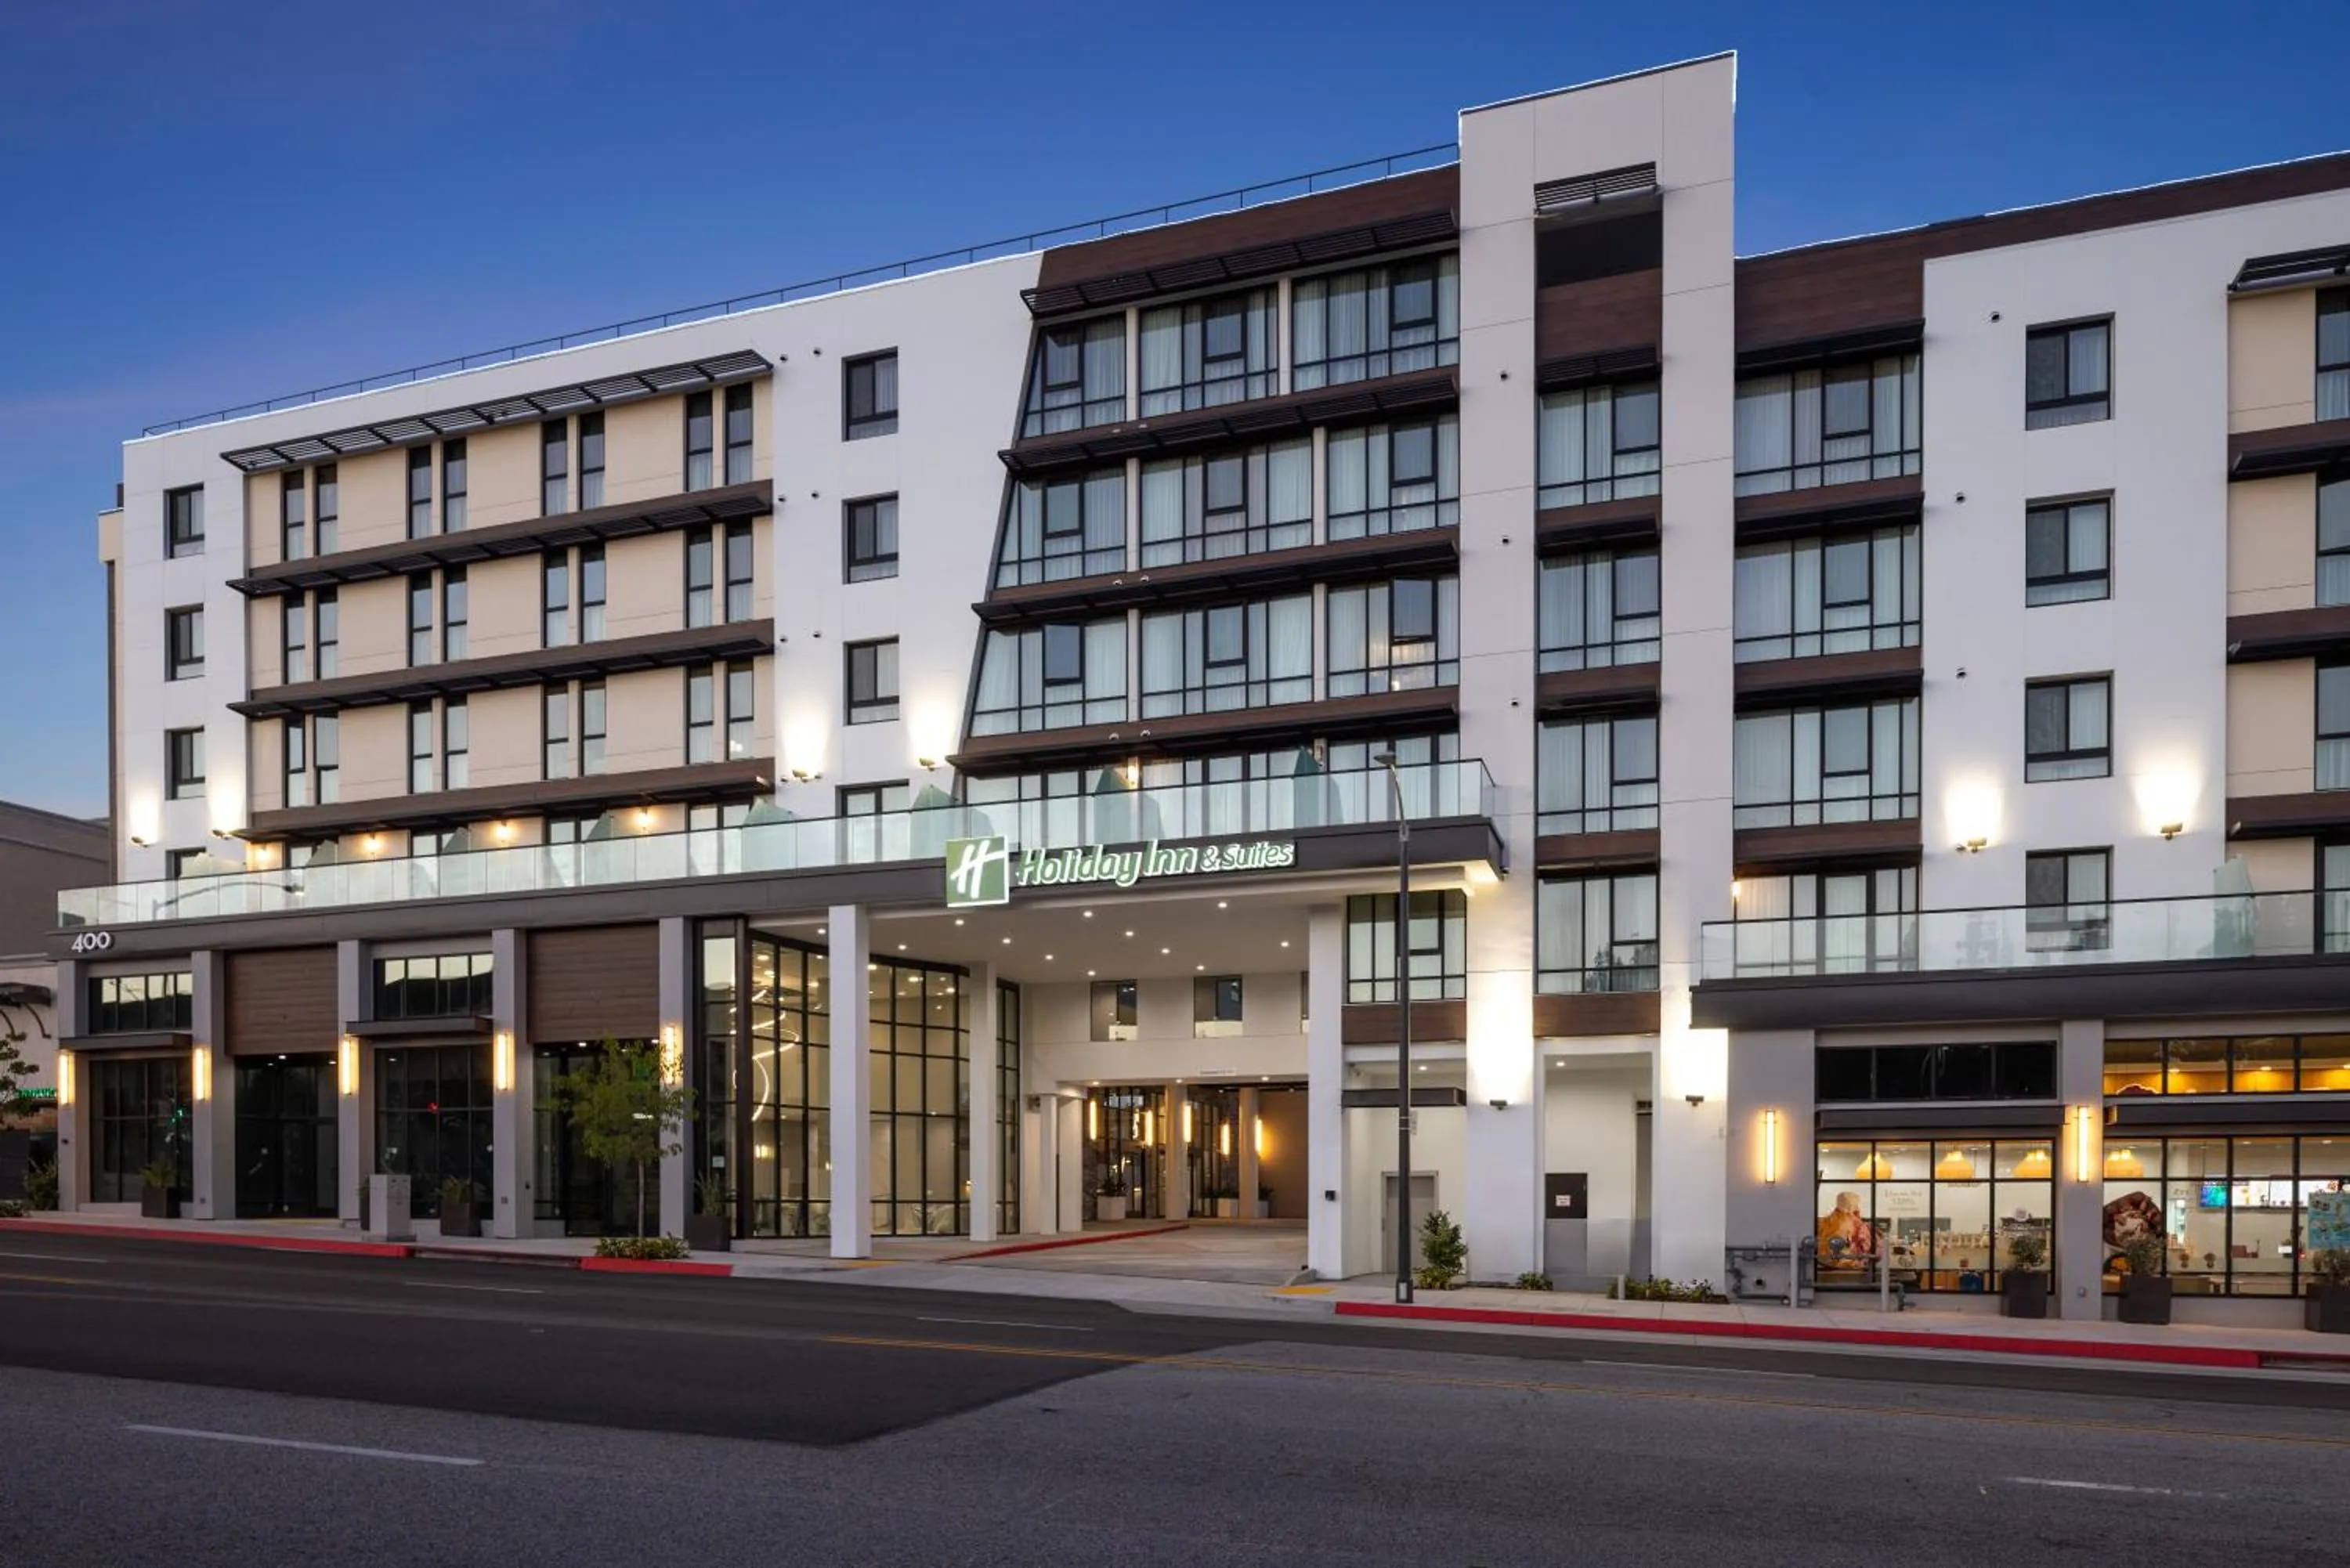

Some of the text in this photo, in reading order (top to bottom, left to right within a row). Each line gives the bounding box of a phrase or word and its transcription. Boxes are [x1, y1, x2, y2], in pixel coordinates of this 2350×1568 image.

[1016, 844, 1143, 887] Holiday
[1143, 839, 1199, 876] Inn
[1199, 845, 1221, 873] &
[70, 931, 110, 953] 400
